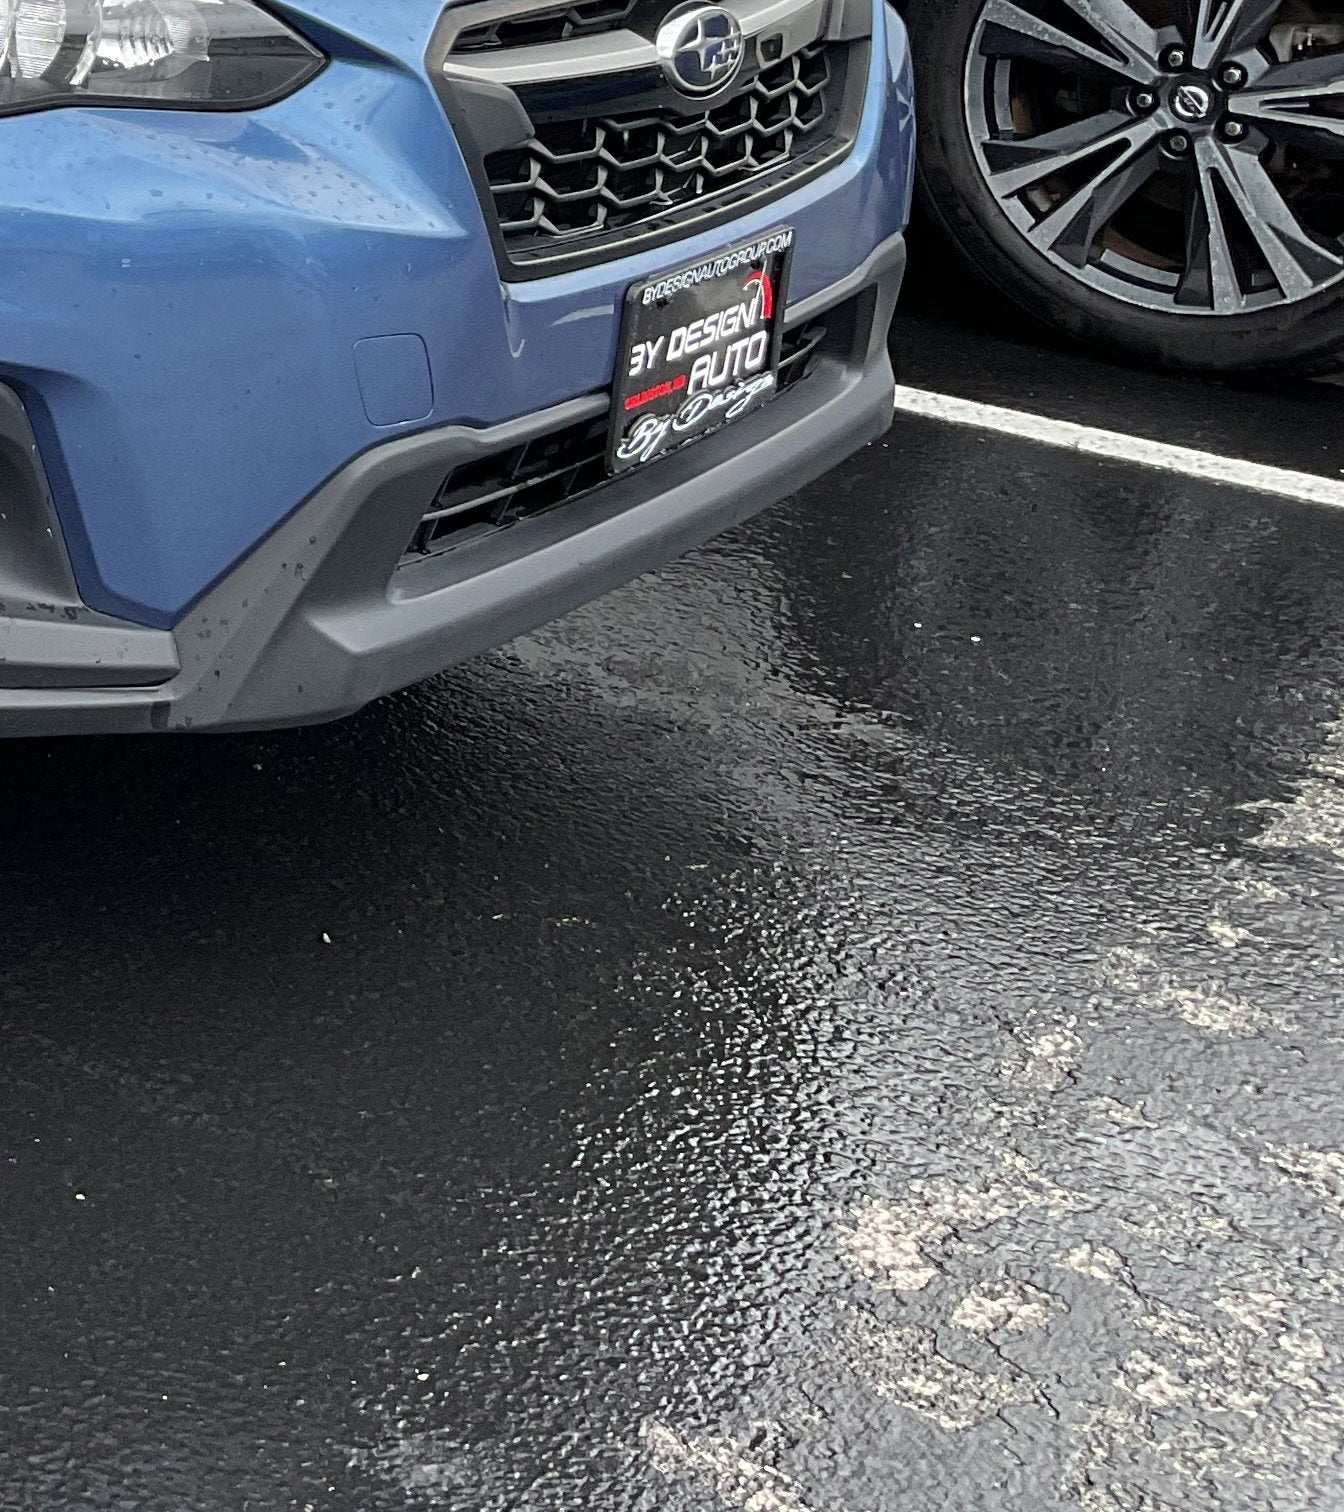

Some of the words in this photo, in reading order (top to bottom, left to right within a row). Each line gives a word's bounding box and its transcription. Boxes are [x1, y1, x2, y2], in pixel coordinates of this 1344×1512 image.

[628, 335, 664, 377] BY
[666, 298, 758, 361] DESIGN
[687, 330, 768, 395] AUTO
[617, 416, 671, 462] By
[672, 375, 774, 431] Design
